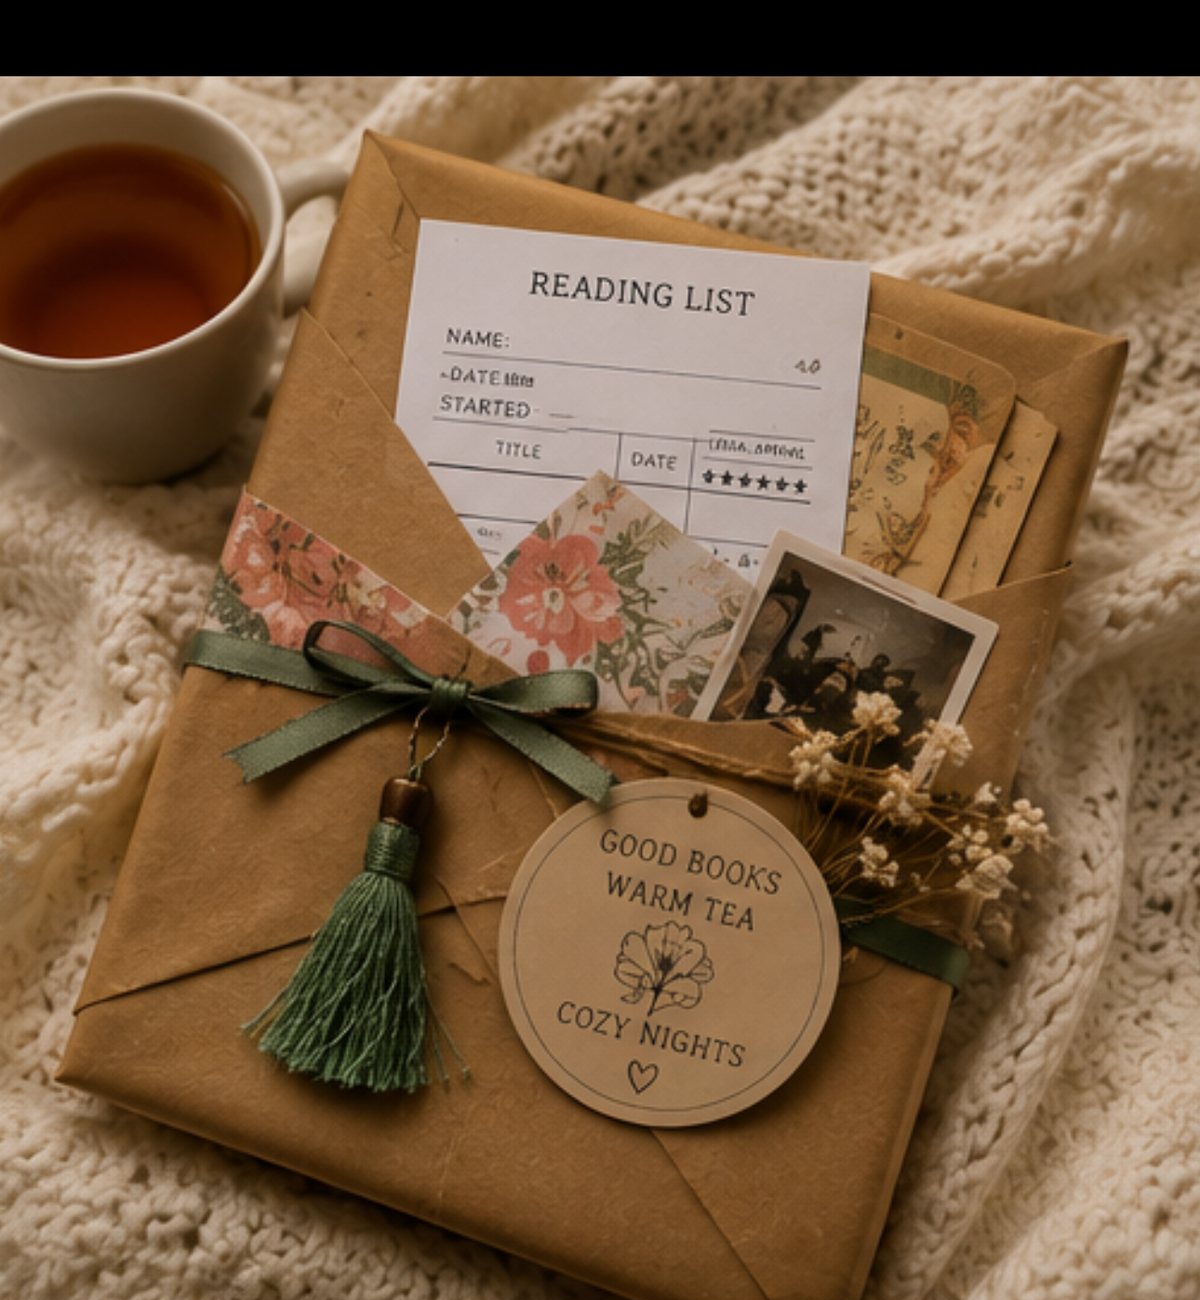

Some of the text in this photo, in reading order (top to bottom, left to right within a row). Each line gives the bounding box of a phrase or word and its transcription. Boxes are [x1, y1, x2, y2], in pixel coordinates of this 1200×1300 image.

[529, 271, 756, 317] READING LIST
[446, 328, 509, 348] NAME:
[440, 394, 531, 419] STARTED
[496, 439, 677, 471] TITLE DATE
[600, 828, 782, 895] GOOD BOOKS
[607, 871, 754, 931] WARM TEA
[557, 1000, 746, 1068] COZY NIGHTS
